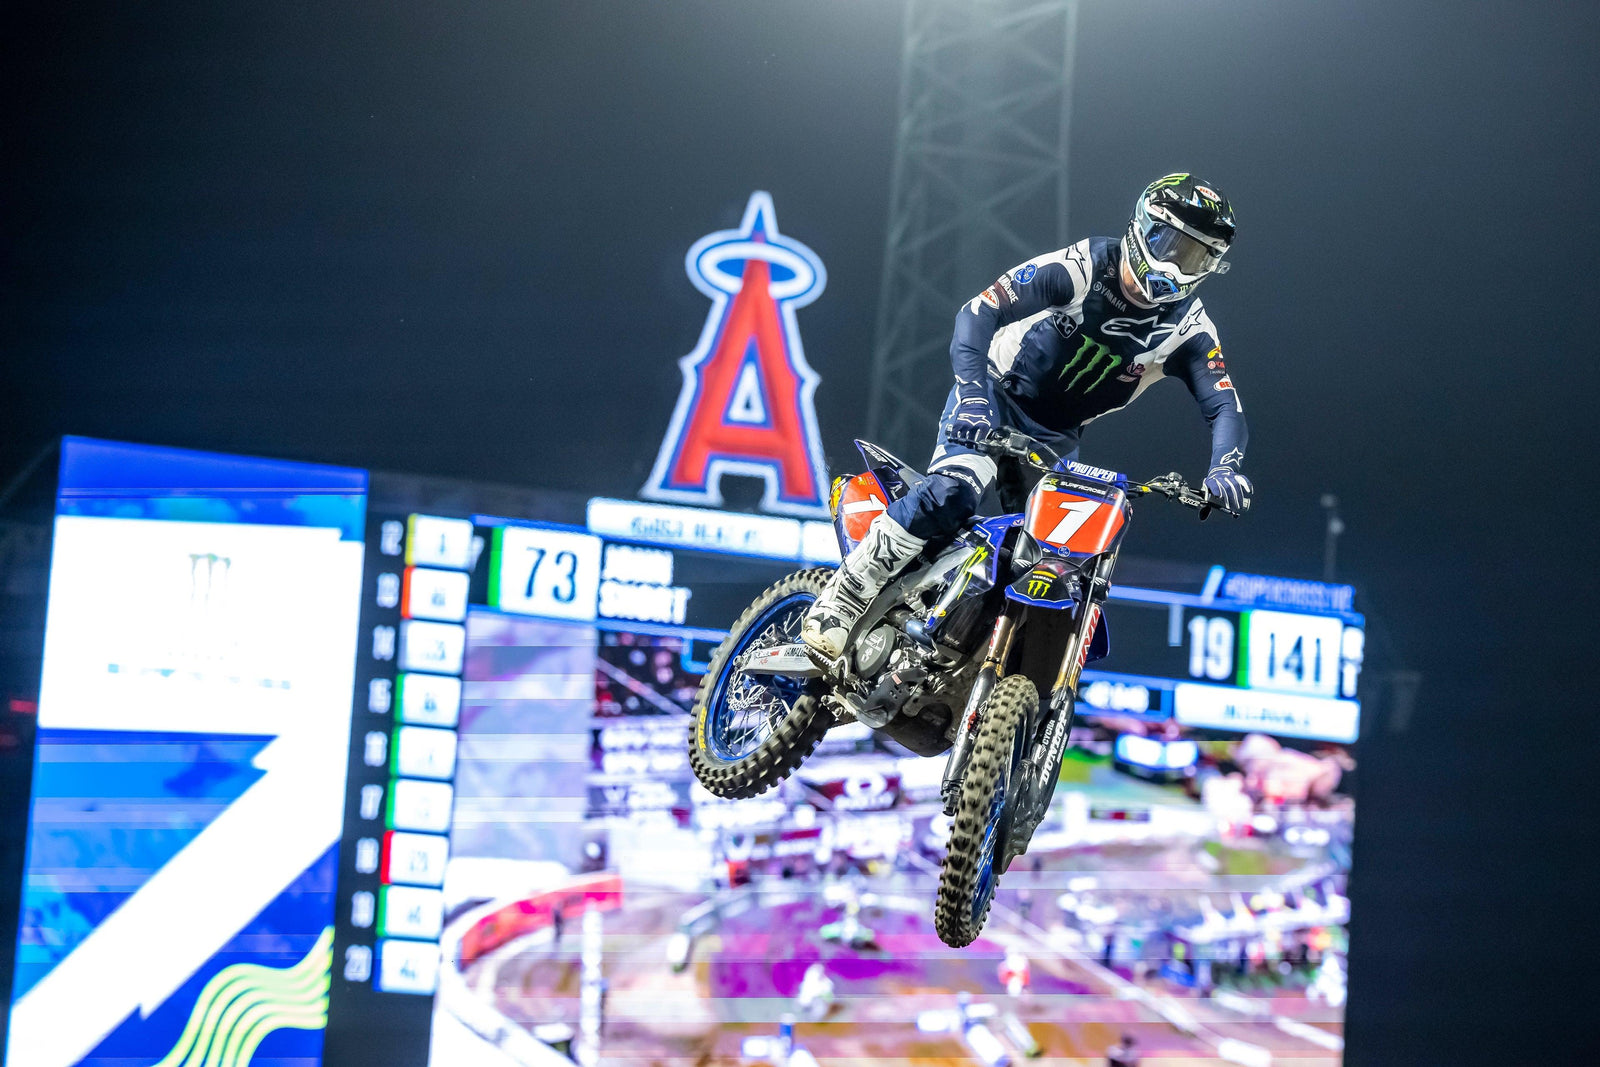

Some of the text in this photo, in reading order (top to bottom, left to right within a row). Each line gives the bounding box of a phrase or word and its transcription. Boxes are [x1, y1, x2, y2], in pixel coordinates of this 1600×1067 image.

[1101, 286, 1127, 312] YAMAHA
[639, 191, 829, 517] A
[1060, 481, 1107, 496] SUPERCROSS
[1068, 461, 1117, 483] PROTAPER
[842, 493, 888, 516] 1
[1044, 500, 1104, 545] 1
[524, 547, 579, 602] 73
[1188, 615, 1235, 680] 19
[1267, 631, 1323, 683] 141
[1040, 709, 1067, 785] DUNLOP
[1042, 719, 1055, 745] CYCRA
